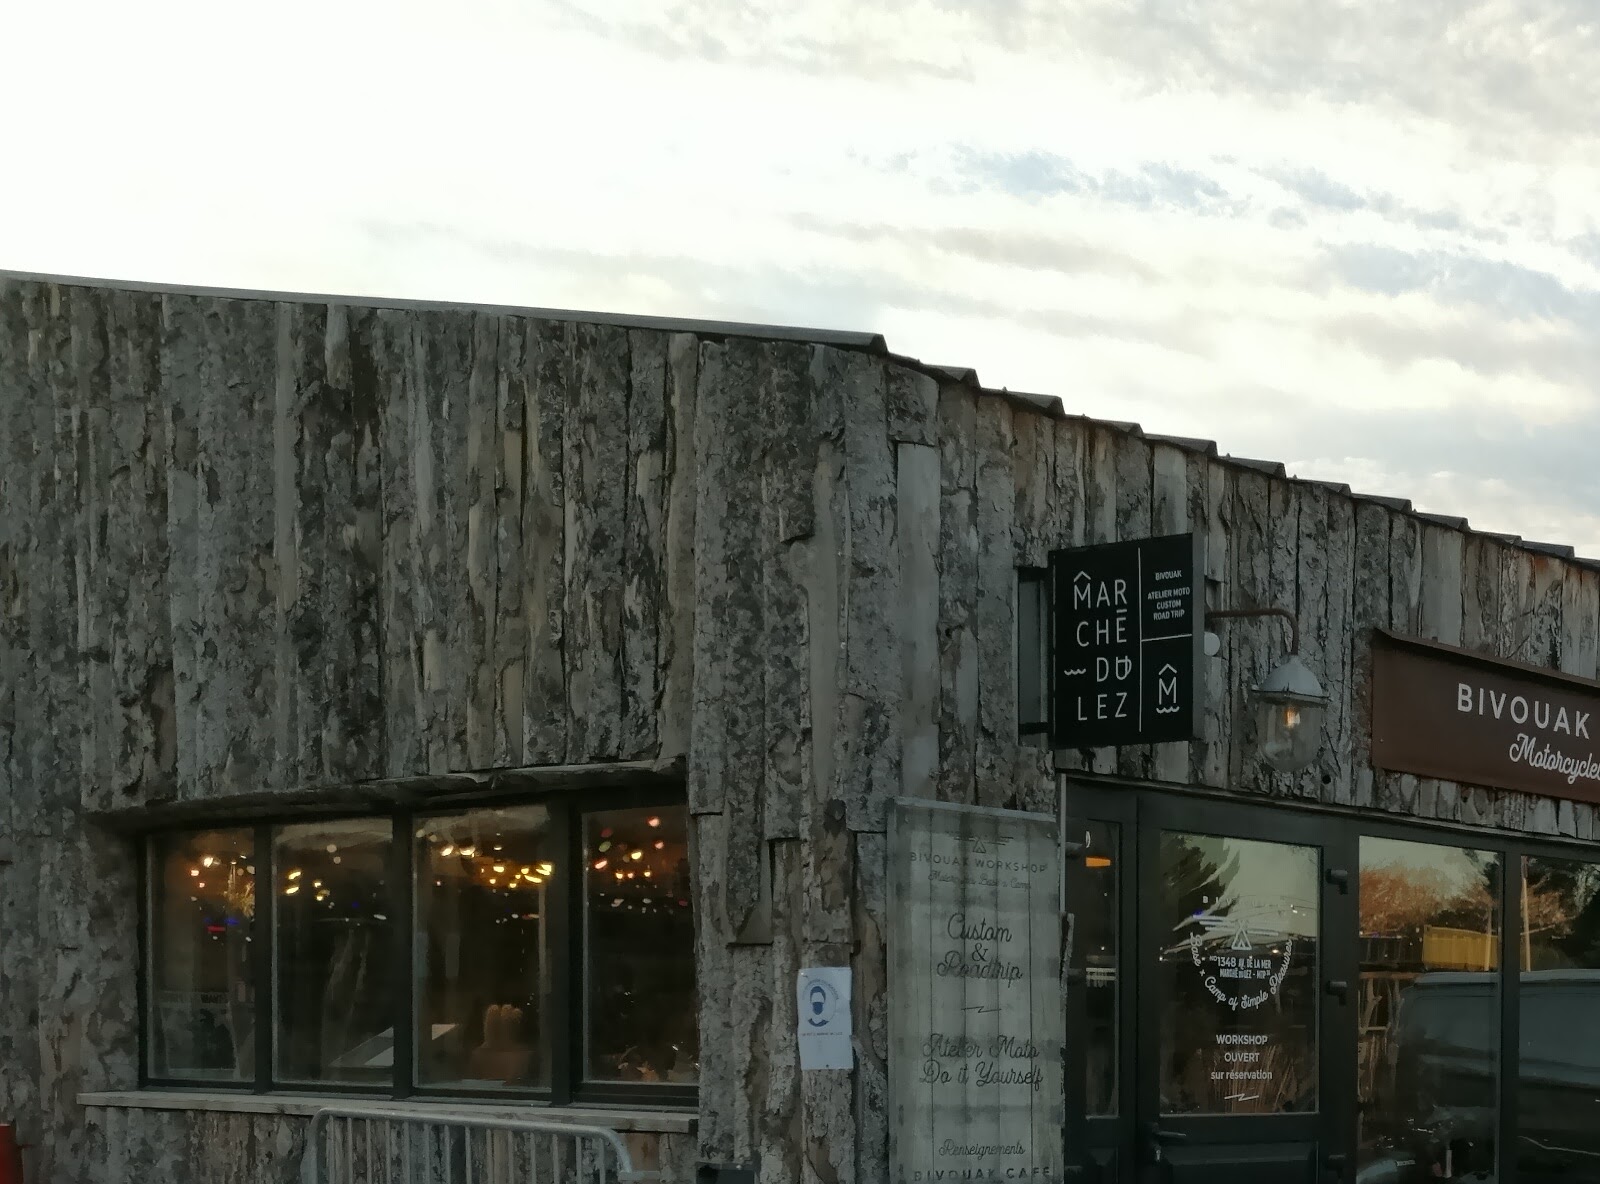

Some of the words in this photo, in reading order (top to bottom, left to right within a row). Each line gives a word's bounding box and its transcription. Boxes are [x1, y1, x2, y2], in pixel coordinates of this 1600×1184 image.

[1155, 570, 1182, 580] BIVOUAK
[1147, 590, 1172, 600] ATELIER
[1173, 587, 1190, 597] MOTO
[1157, 600, 1182, 610] CUSTOM
[1153, 611, 1170, 620] ROAD
[1171, 609, 1185, 618] TRIP
[1077, 692, 1128, 721] LEZ
[1458, 682, 1590, 740] BIVOUAK
[975, 858, 1048, 872] WORKSHOP
[947, 913, 1012, 942] Custom
[972, 943, 988, 962] &
[1205, 976, 1226, 1003] Camp
[1228, 996, 1239, 1011] of
[1241, 990, 1269, 1010] Simple
[1269, 939, 1293, 995] Pleasures
[989, 1035, 1040, 1058] Moto
[1216, 1034, 1268, 1045] WORKSHOP
[1224, 1052, 1260, 1063] OUVERT
[920, 1059, 952, 1083] Do
[958, 1063, 969, 1085] it
[975, 1061, 1044, 1091] Yourself
[1211, 1071, 1224, 1080] sur
[938, 1138, 1027, 1160] Renseignements
[913, 1168, 995, 1182] BIVOUAK
